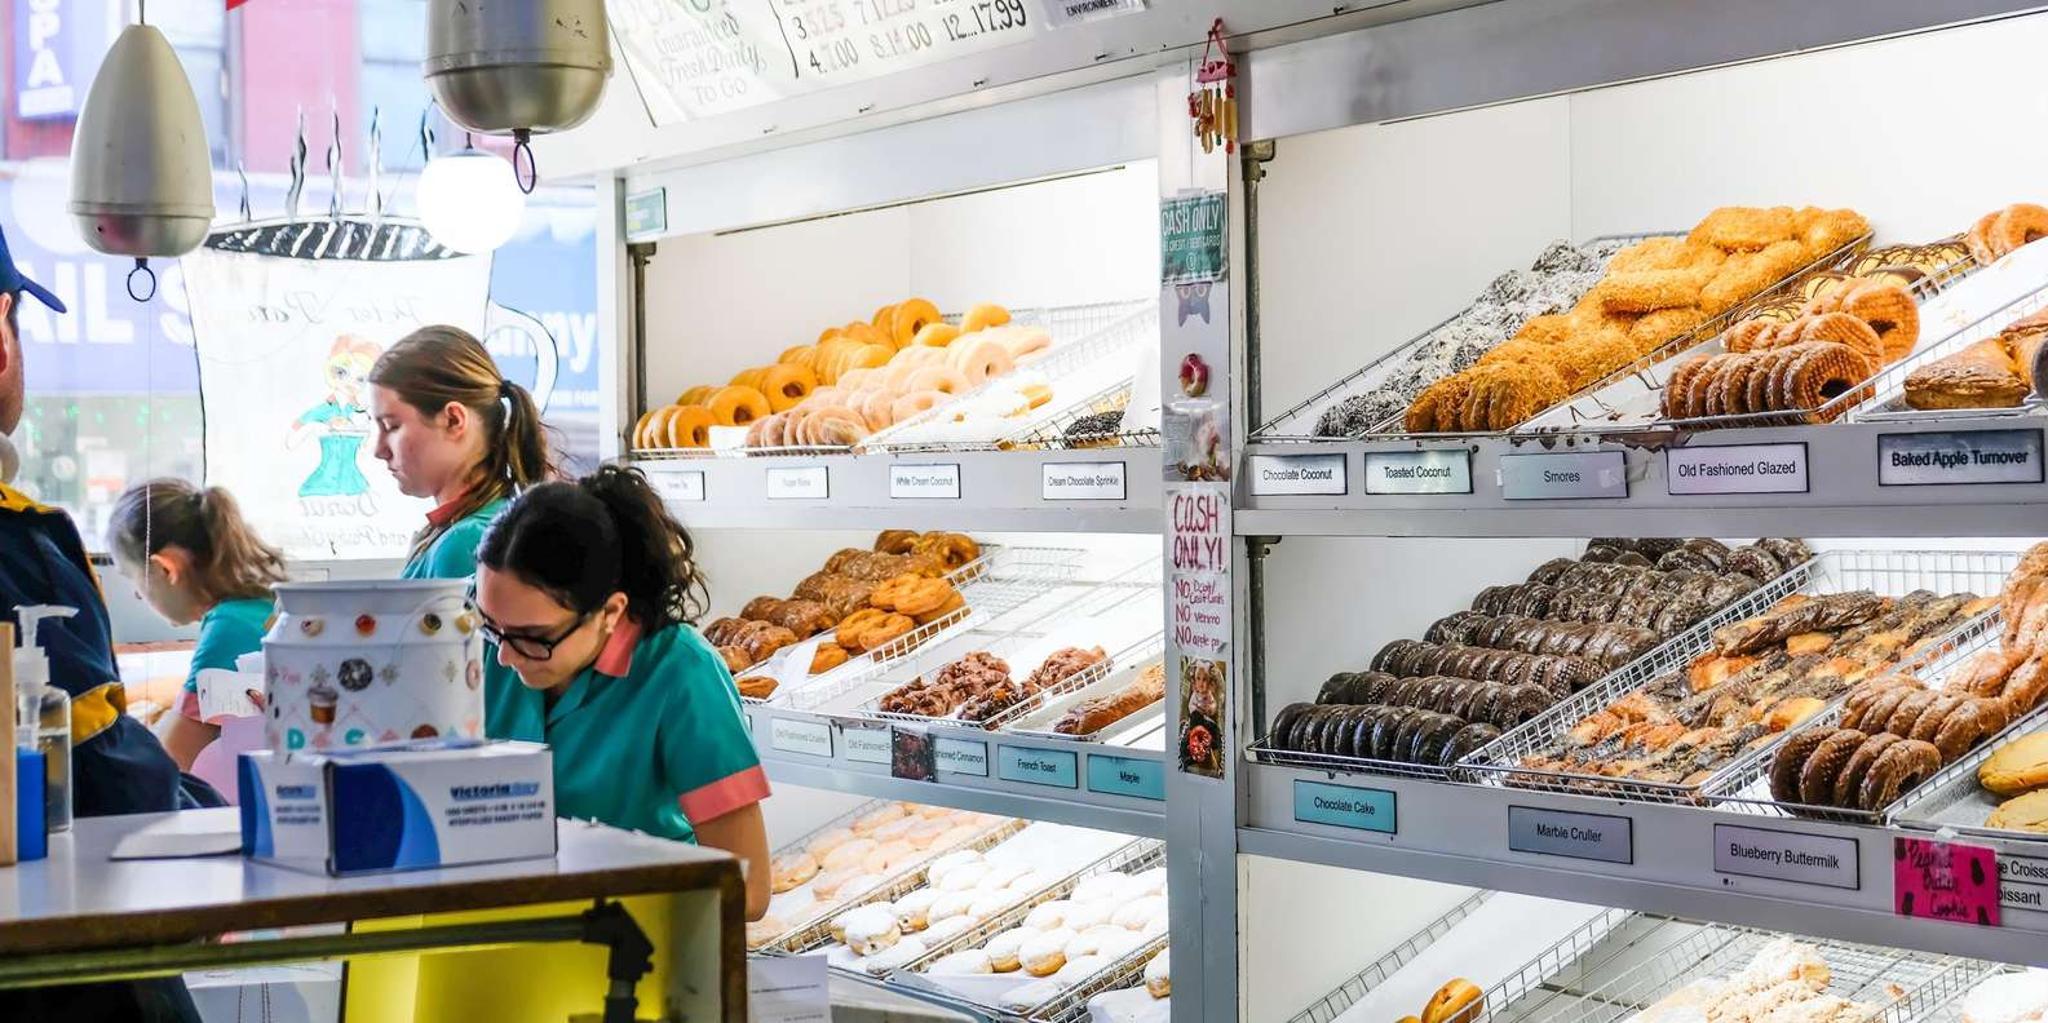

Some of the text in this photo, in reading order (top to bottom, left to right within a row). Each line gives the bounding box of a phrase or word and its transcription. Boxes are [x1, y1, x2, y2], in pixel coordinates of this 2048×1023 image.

[1162, 203, 1220, 237] CASH ONLY
[1892, 449, 2029, 470] Baked Apple Turnover
[1263, 468, 1333, 481] Chocolate Coconut
[1384, 465, 1451, 479] Toasted Coconut
[1543, 470, 1581, 483] Smores
[1678, 461, 1796, 477] Old Fashioned Glazed
[911, 477, 929, 487] Cream
[930, 477, 953, 487] Coconut
[1048, 477, 1066, 487] Cream
[1067, 476, 1094, 487] Chocolate
[1174, 536, 1222, 571] ONLY!
[1175, 579, 1191, 599] NO
[1175, 604, 1191, 623] NO
[1175, 625, 1192, 645] NO
[1018, 758, 1056, 773] French Toast
[1120, 771, 1140, 785] Maple
[1314, 796, 1375, 815] Chocolate Cake
[1537, 824, 1602, 842] Marble Cruller
[1730, 843, 1840, 869] Blueberry Buttermilk
